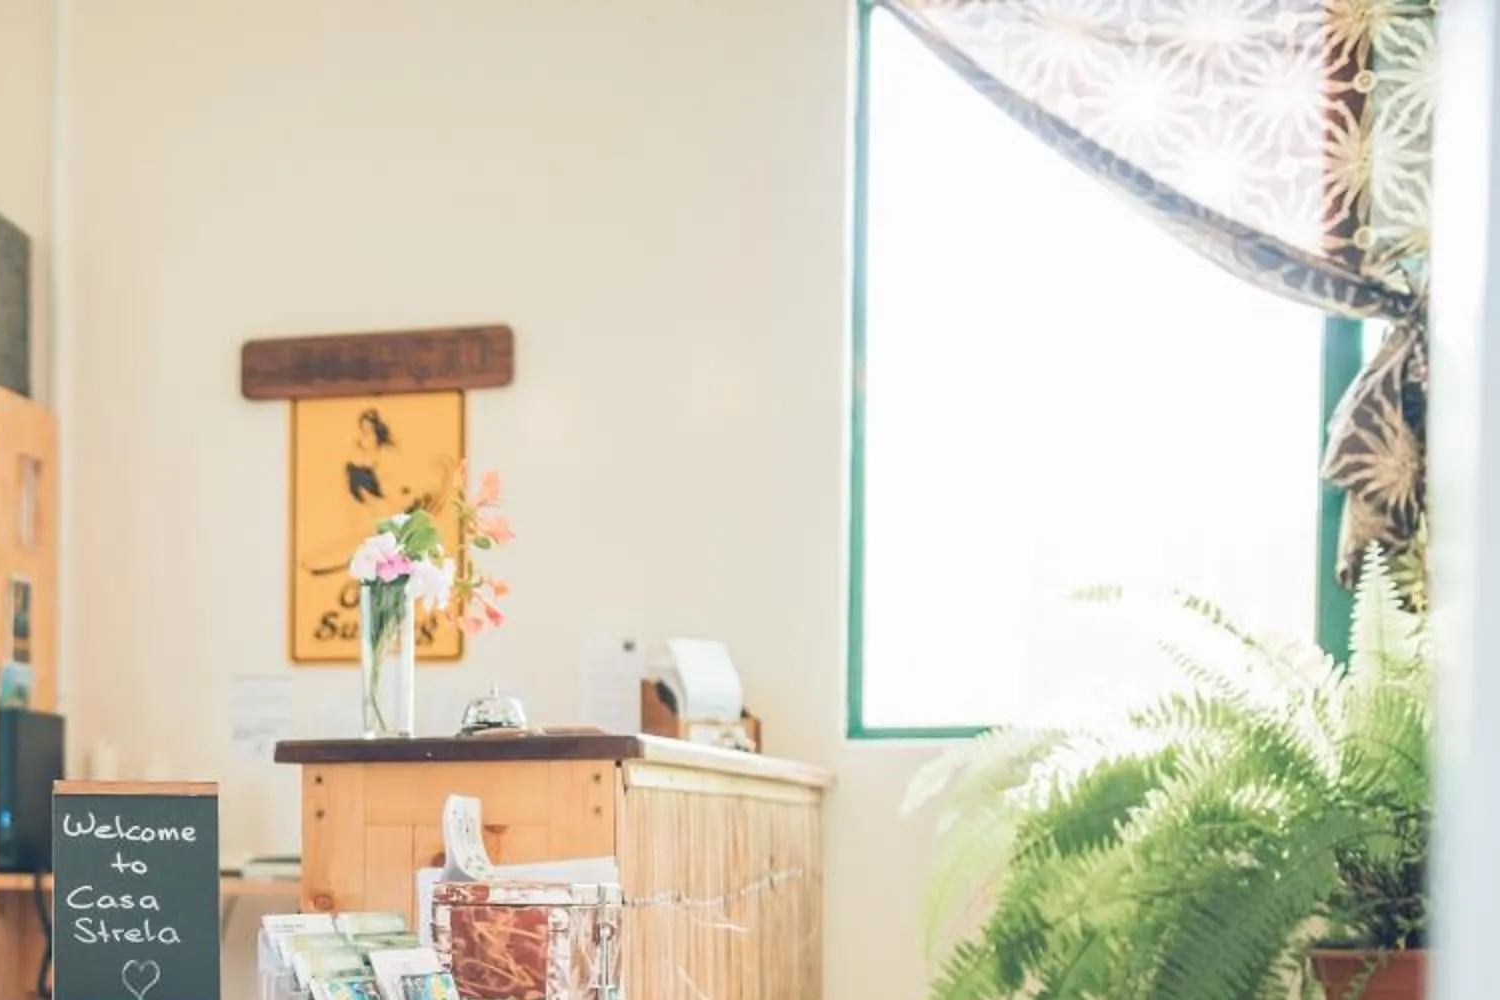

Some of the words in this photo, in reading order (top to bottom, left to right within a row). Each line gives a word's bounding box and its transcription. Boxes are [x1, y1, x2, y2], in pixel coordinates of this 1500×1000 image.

[62, 811, 197, 842] Welcome
[110, 852, 148, 874] to
[66, 884, 160, 911] Casa
[73, 916, 181, 944] Strela
